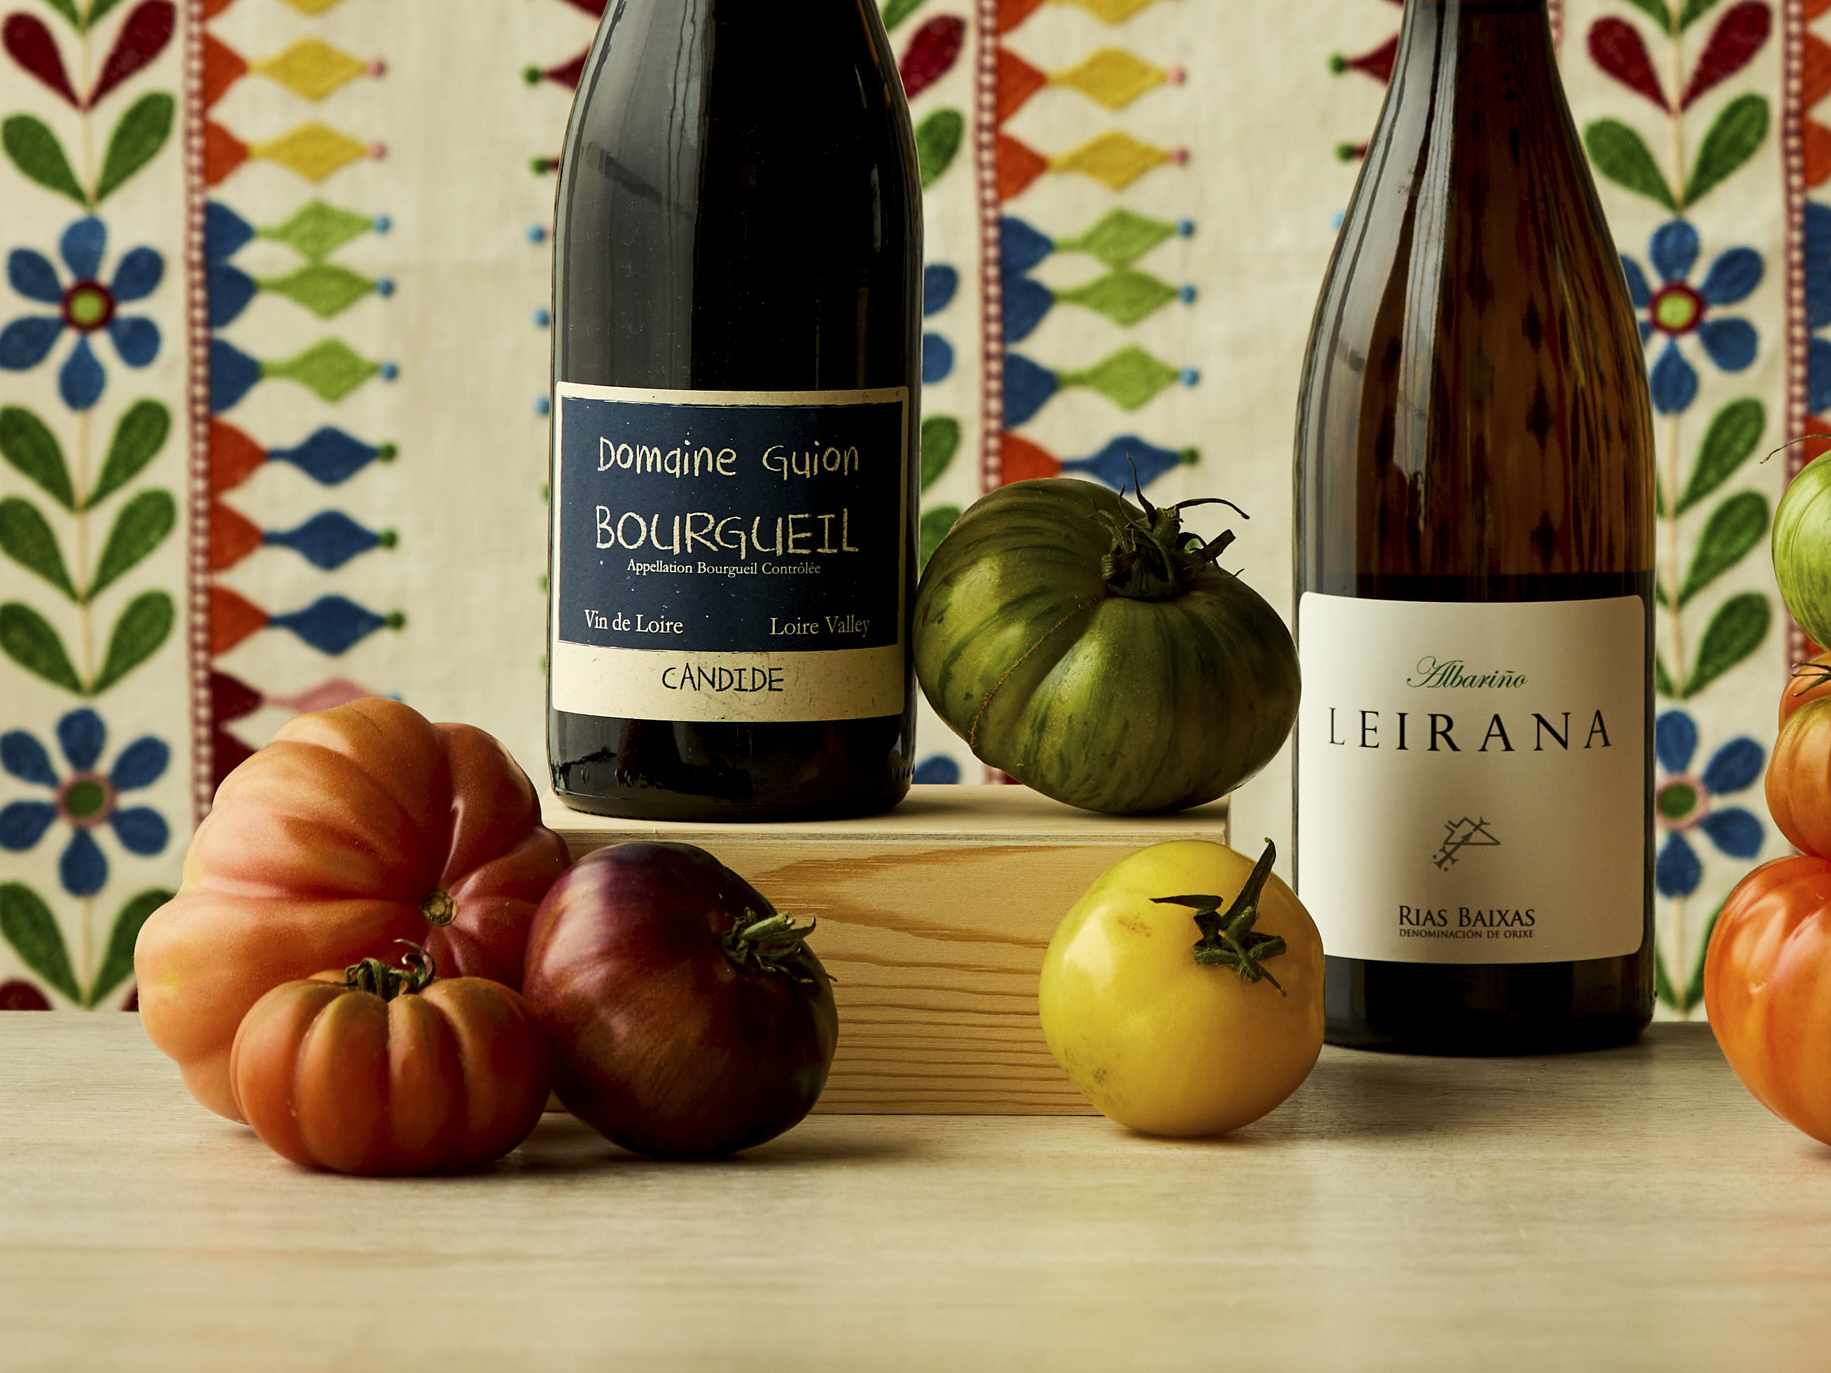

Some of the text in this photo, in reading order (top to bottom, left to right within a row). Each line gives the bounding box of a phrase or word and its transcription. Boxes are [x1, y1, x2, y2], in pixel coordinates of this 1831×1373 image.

[597, 436, 859, 481] Domaine Guion
[595, 505, 859, 559] BOURGUEIL
[626, 558, 821, 578] Appellation Bourgueil Contrôlée
[585, 610, 684, 634] Vin de Loire
[769, 614, 870, 637] Loire Valley
[661, 663, 784, 692] CANDIDE
[1406, 655, 1528, 688] Albariño
[1328, 706, 1612, 752] LEIRANA
[1399, 928, 1534, 940] DENOMINACIÓN DE ORIXE
